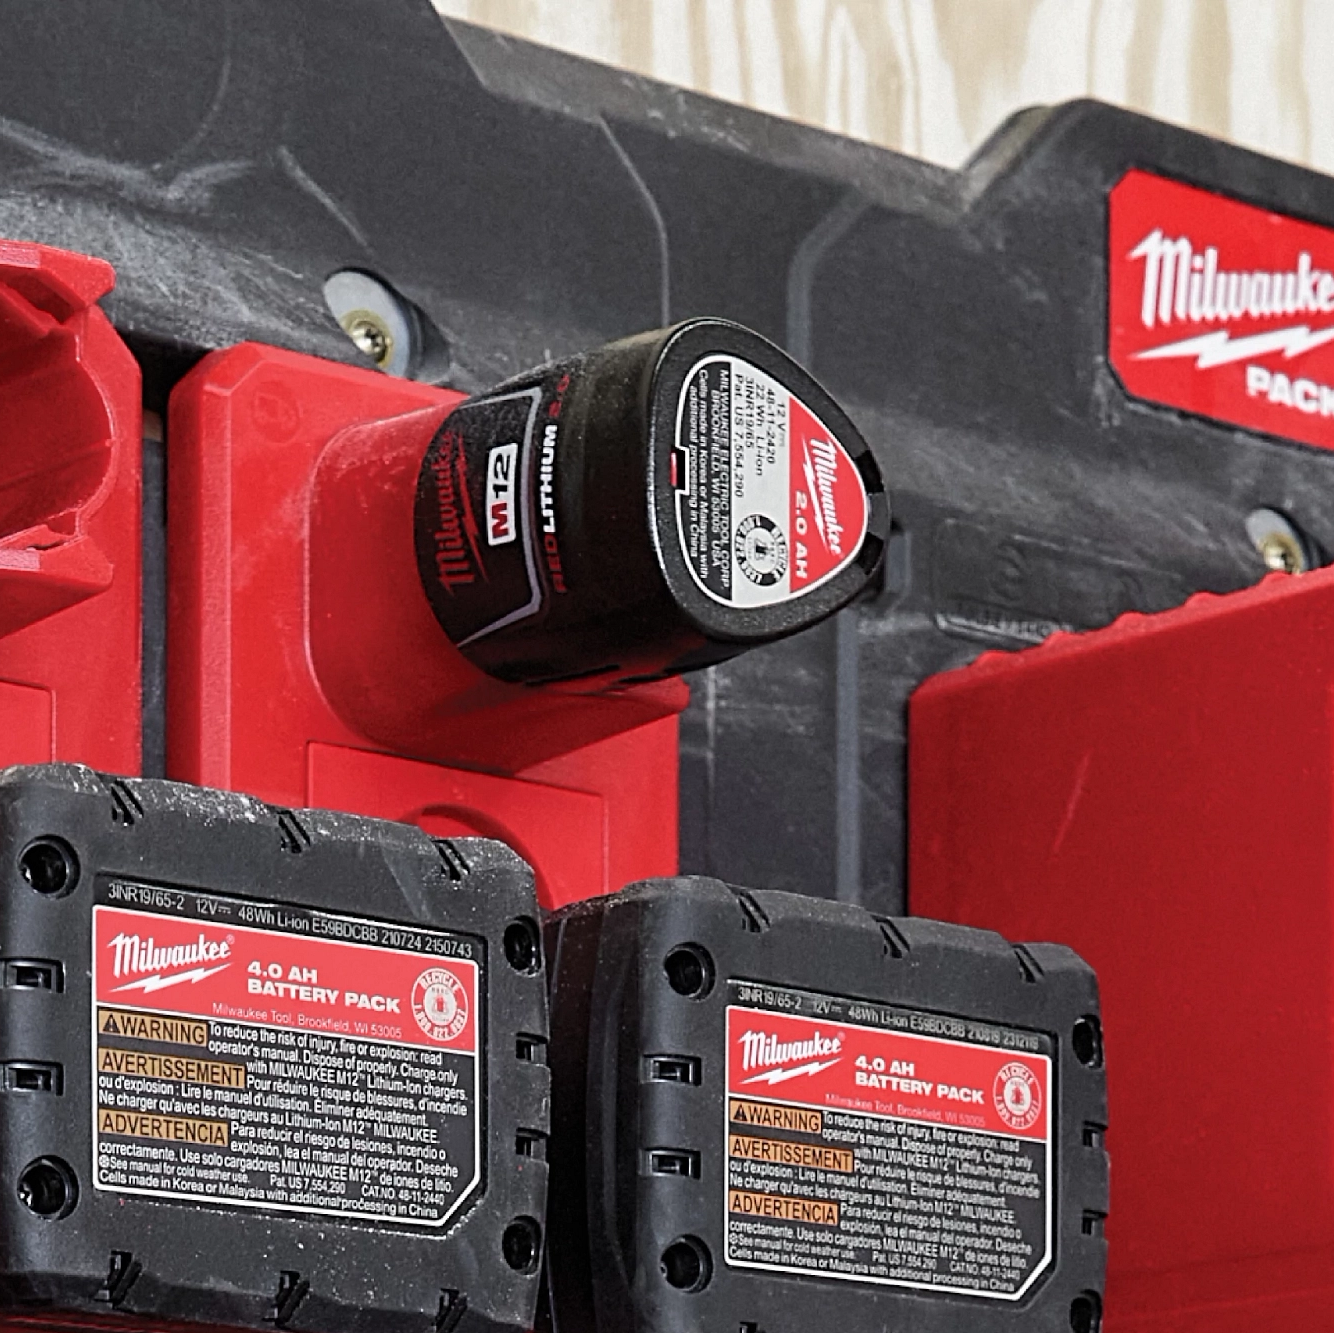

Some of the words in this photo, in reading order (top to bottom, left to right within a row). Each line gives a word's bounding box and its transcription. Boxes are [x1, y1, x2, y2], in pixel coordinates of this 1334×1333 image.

[699, 369, 707, 396] Cells
[734, 373, 743, 399] Pat.
[689, 385, 698, 442] additional
[699, 400, 707, 432] made
[720, 369, 728, 446] MILWAUKEE
[734, 406, 743, 425] US
[699, 436, 707, 446] in
[710, 389, 720, 473] BROOKFIELD,
[766, 388, 775, 463] 48-11-2420
[689, 447, 698, 505] processing
[699, 450, 707, 482] Korea
[720, 450, 728, 510] ELECTRIC
[734, 431, 743, 496] 7,554,290
[490, 453, 510, 539] M12
[699, 486, 707, 497] or
[710, 478, 720, 493] WI
[540, 424, 566, 592] REDLITHIUM
[689, 509, 698, 520] in
[710, 497, 720, 532] 53005
[795, 491, 806, 536] 2.0
[689, 524, 698, 556] China
[699, 502, 707, 550] Malaysia
[720, 514, 728, 545] TOOL
[699, 554, 707, 578] with
[710, 540, 720, 566] USA
[720, 549, 728, 588] CORP.
[795, 542, 806, 578] AH
[108, 884, 184, 912] 3INR19/65-2
[238, 904, 273, 926] 48Wh
[277, 911, 308, 931] Li-ion
[312, 916, 377, 942] E59BDCBB
[381, 927, 421, 949] 210724
[425, 934, 471, 957] 2150743
[247, 959, 282, 979] 4.0
[288, 965, 317, 984] AH
[248, 976, 338, 1005] BATTERY
[345, 991, 400, 1014] PACK
[121, 1015, 204, 1045] WARNING
[212, 1001, 266, 1020] Milwaukee
[271, 1009, 293, 1024] Tool,
[299, 1013, 351, 1032] Brookfield,
[354, 1021, 367, 1034] WI
[370, 1023, 401, 1039] 53005
[209, 1022, 221, 1036] To
[223, 1024, 257, 1041] reduce
[260, 1029, 275, 1043] the
[277, 1031, 294, 1046] risk
[297, 1034, 306, 1048] of
[308, 1035, 338, 1052] injury,
[339, 1040, 355, 1054] fire
[358, 1042, 367, 1056] or
[369, 1044, 418, 1063] explosion:
[420, 1051, 441, 1066] read
[102, 1050, 242, 1087] AVERTISSEMENT
[854, 1053, 884, 1071] 4.0
[889, 1059, 914, 1076] AH
[855, 1070, 932, 1096] BATTERY
[937, 1083, 984, 1104] PACK
[102, 1111, 225, 1144] ADVERTENCIA
[748, 1105, 818, 1131] WARNING
[732, 1137, 850, 1170] AVERTISSEMENT
[732, 1193, 835, 1223] ADVERTENCIA
